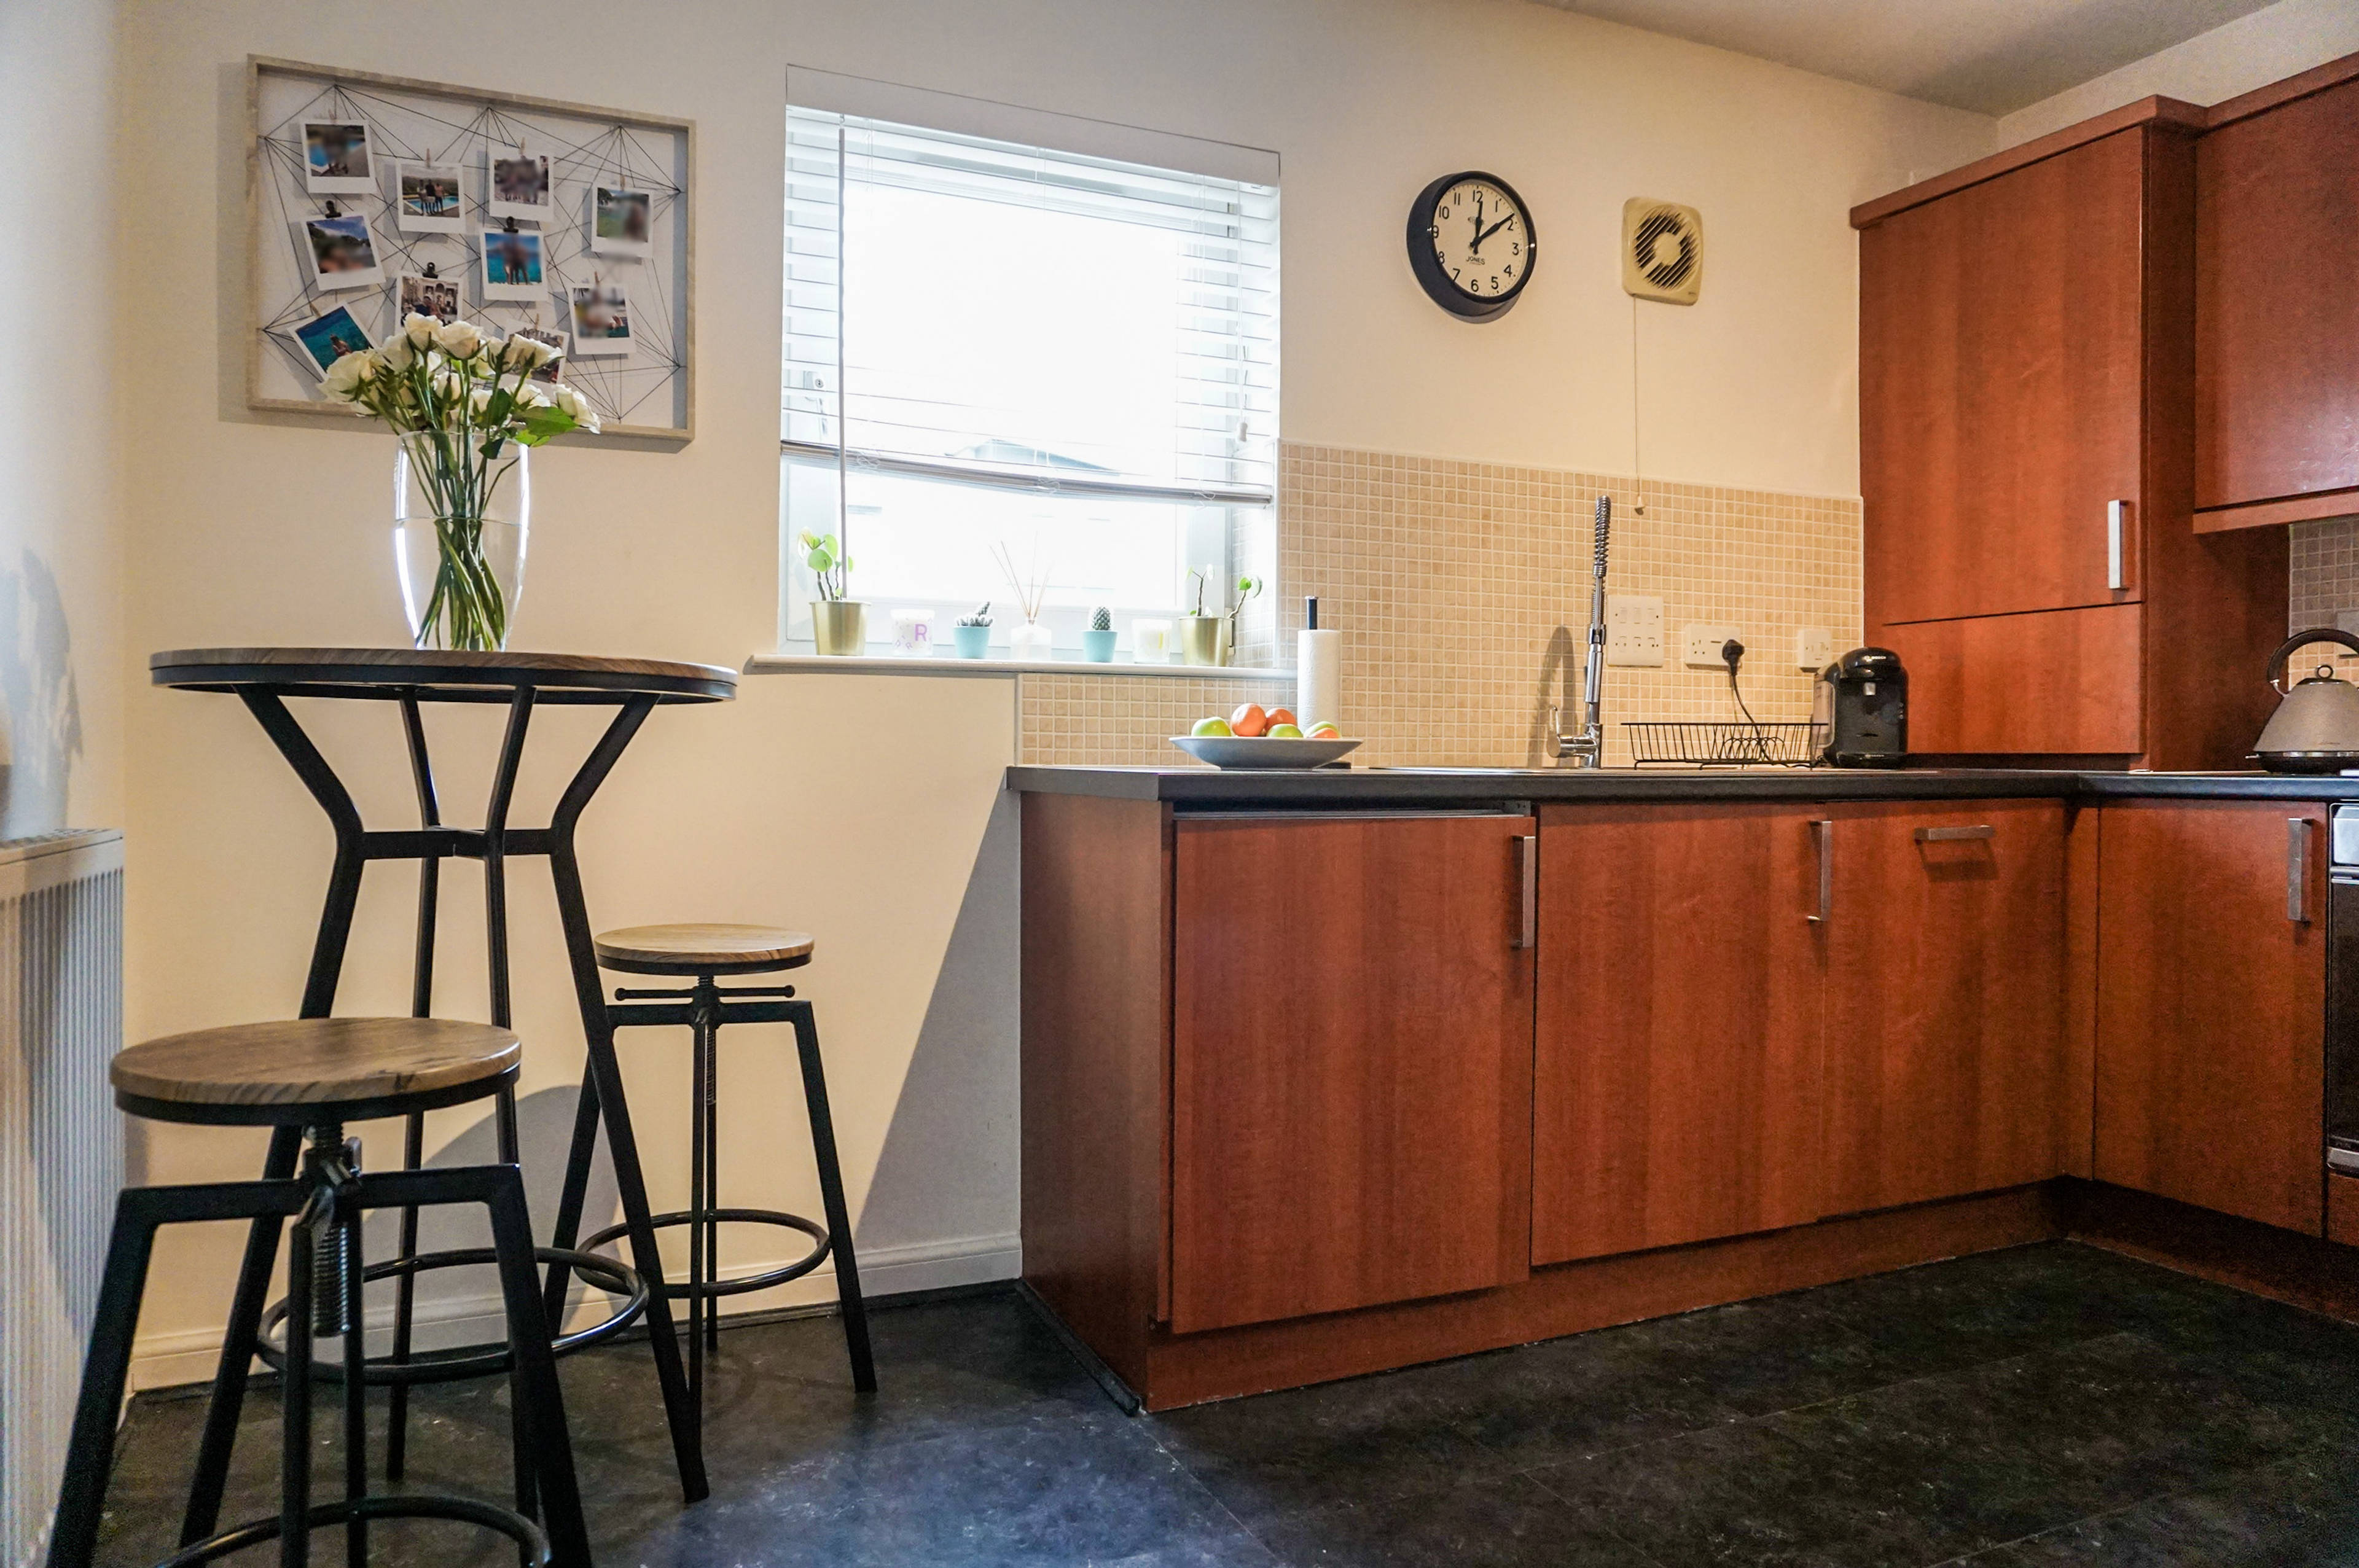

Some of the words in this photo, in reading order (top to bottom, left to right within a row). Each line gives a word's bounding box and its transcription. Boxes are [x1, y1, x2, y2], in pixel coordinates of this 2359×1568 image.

[1453, 192, 1460, 205] 11
[1473, 190, 1483, 203] 12
[1439, 205, 1450, 219] 10
[1495, 200, 1498, 213] 1
[1432, 225, 1439, 238] 9
[1507, 219, 1514, 231] 2
[1512, 243, 1519, 255] 3
[1438, 251, 1445, 264] 8
[1465, 255, 1485, 265] JONES
[1453, 268, 1460, 282] 7
[1504, 264, 1512, 278] 4
[1471, 279, 1479, 292] 6
[1491, 276, 1498, 289] 5
[915, 624, 927, 641] R
